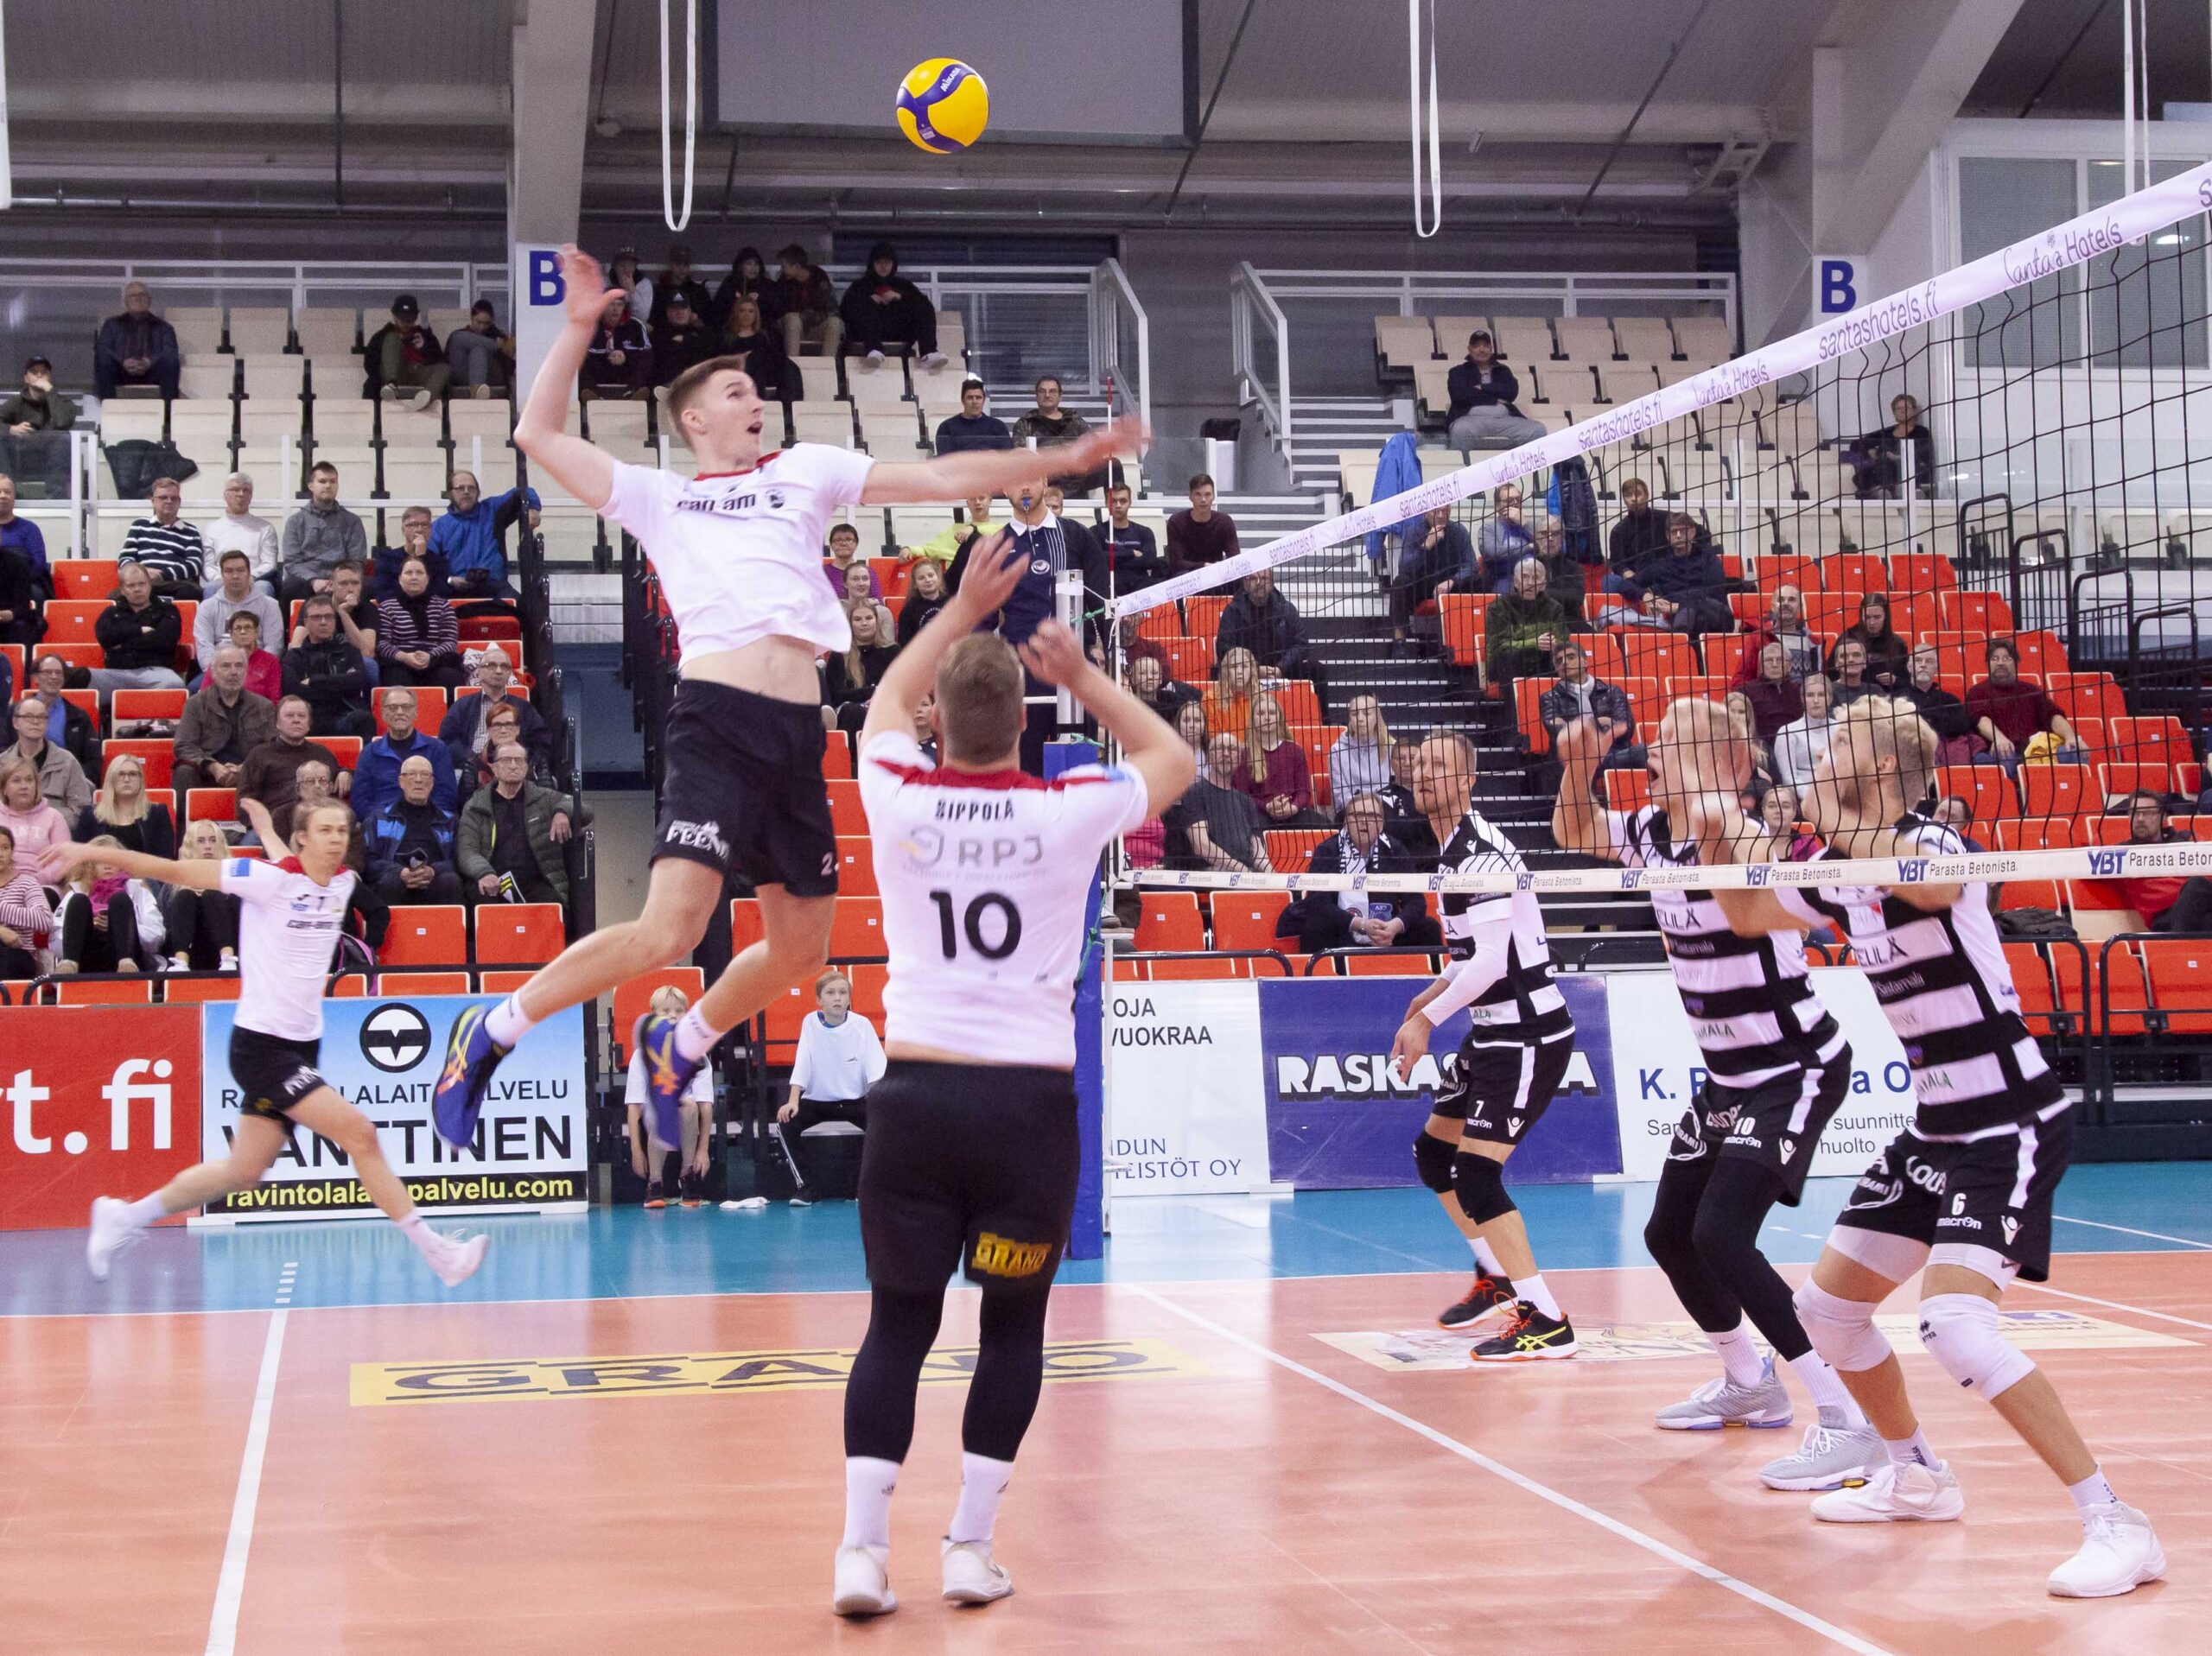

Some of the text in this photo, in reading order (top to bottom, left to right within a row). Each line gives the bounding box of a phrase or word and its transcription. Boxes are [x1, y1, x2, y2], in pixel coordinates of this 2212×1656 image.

[2064, 215, 2123, 263] Hotels
[529, 250, 568, 306] B
[1821, 261, 1856, 313] B
[1818, 281, 1937, 360] santashotels.fi
[1578, 393, 1663, 450] santashotels.fi
[1399, 473, 1462, 518] santashotels.fi
[1897, 859, 1929, 882] YBT
[1929, 863, 1966, 877] Parasta
[2088, 848, 2130, 875] YBT
[2129, 852, 2174, 866] Parasta
[1353, 876, 1367, 890] YBT
[1428, 875, 1444, 891] YBT
[1516, 873, 1535, 890] YBT
[1621, 870, 1643, 889] YBT
[1746, 865, 1772, 886] YBT
[1771, 868, 1800, 881] Parasta
[929, 887, 1022, 960] 10
[1112, 998, 1157, 1018] OJA
[1639, 1068, 1676, 1100] K.
[0, 1059, 173, 1154] t.fi
[1474, 1100, 1484, 1117] 7
[1733, 1116, 1756, 1136] 10
[1833, 1113, 1916, 1131] suunnitte
[1110, 1138, 1166, 1156] DUN
[1820, 1137, 1876, 1154] huolto
[1209, 1158, 1242, 1177] OY
[226, 1177, 574, 1208] ravintolalapalvelu.com
[1951, 1192, 1966, 1216] 6
[393, 1350, 1148, 1390] GRAO
